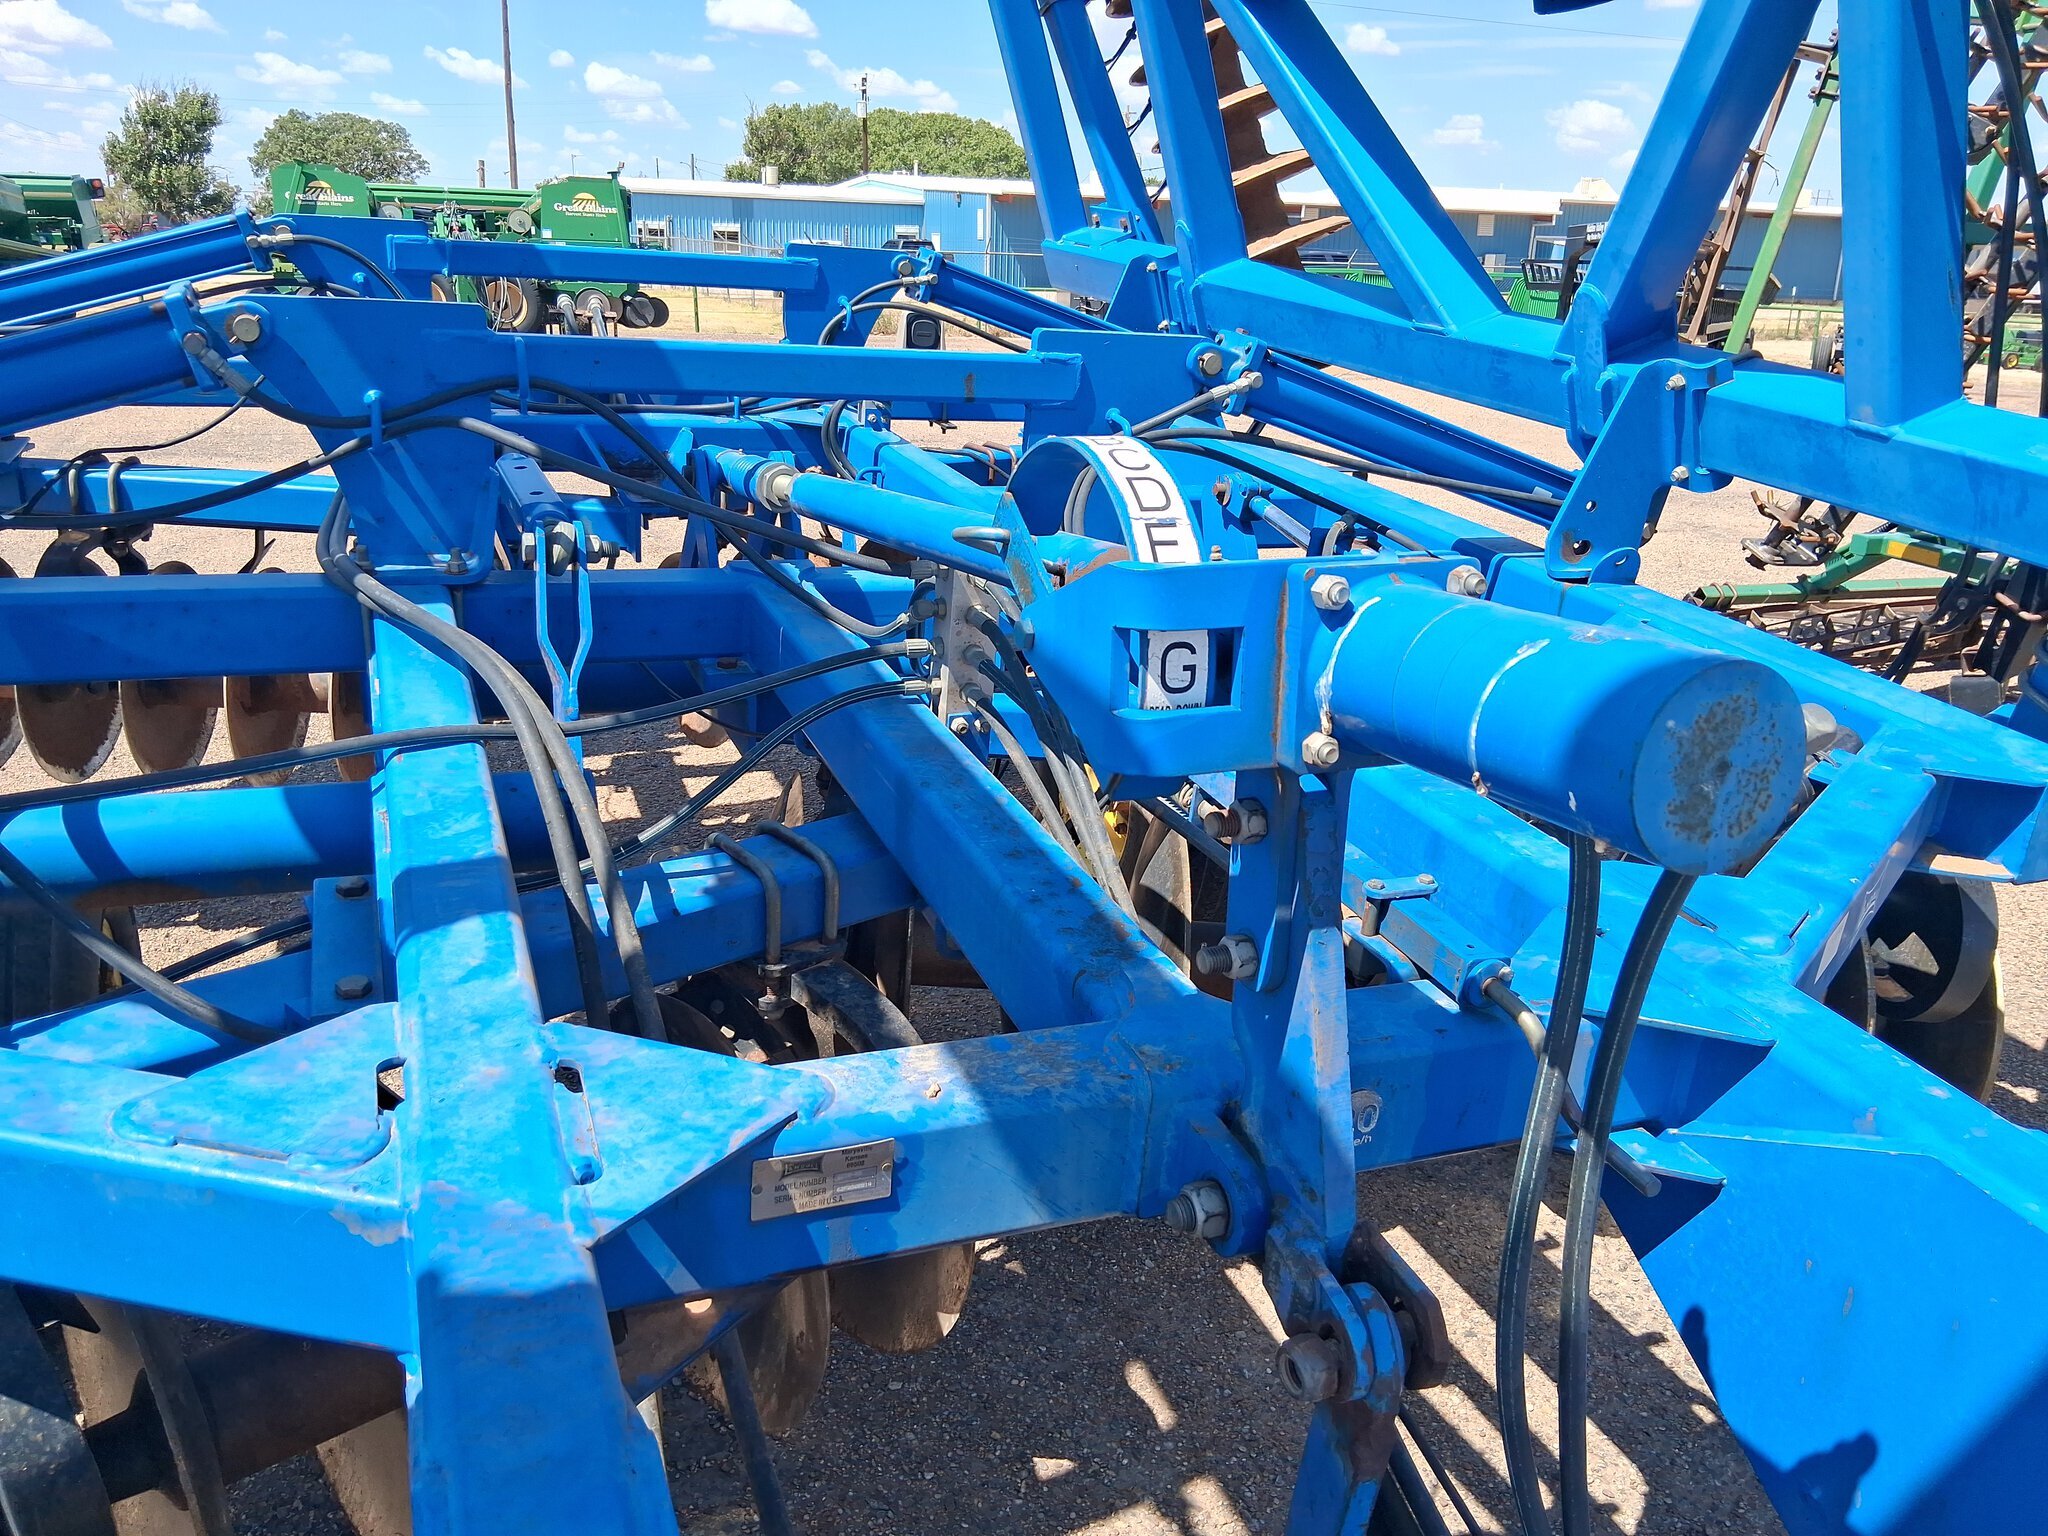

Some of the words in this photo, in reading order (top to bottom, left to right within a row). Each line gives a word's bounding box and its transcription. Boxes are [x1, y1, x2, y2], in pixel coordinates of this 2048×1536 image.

[553, 203, 583, 212] Great
[583, 204, 618, 214] Plains
[1126, 477, 1171, 512] D
[1160, 641, 1197, 694] G
[774, 1182, 798, 1193] MODEL
[798, 1176, 827, 1188] NUMBER
[774, 1193, 798, 1204] SERIAL
[798, 1188, 827, 1199] NUMBER
[798, 1199, 817, 1209] MADE
[818, 1198, 826, 1206] IN
